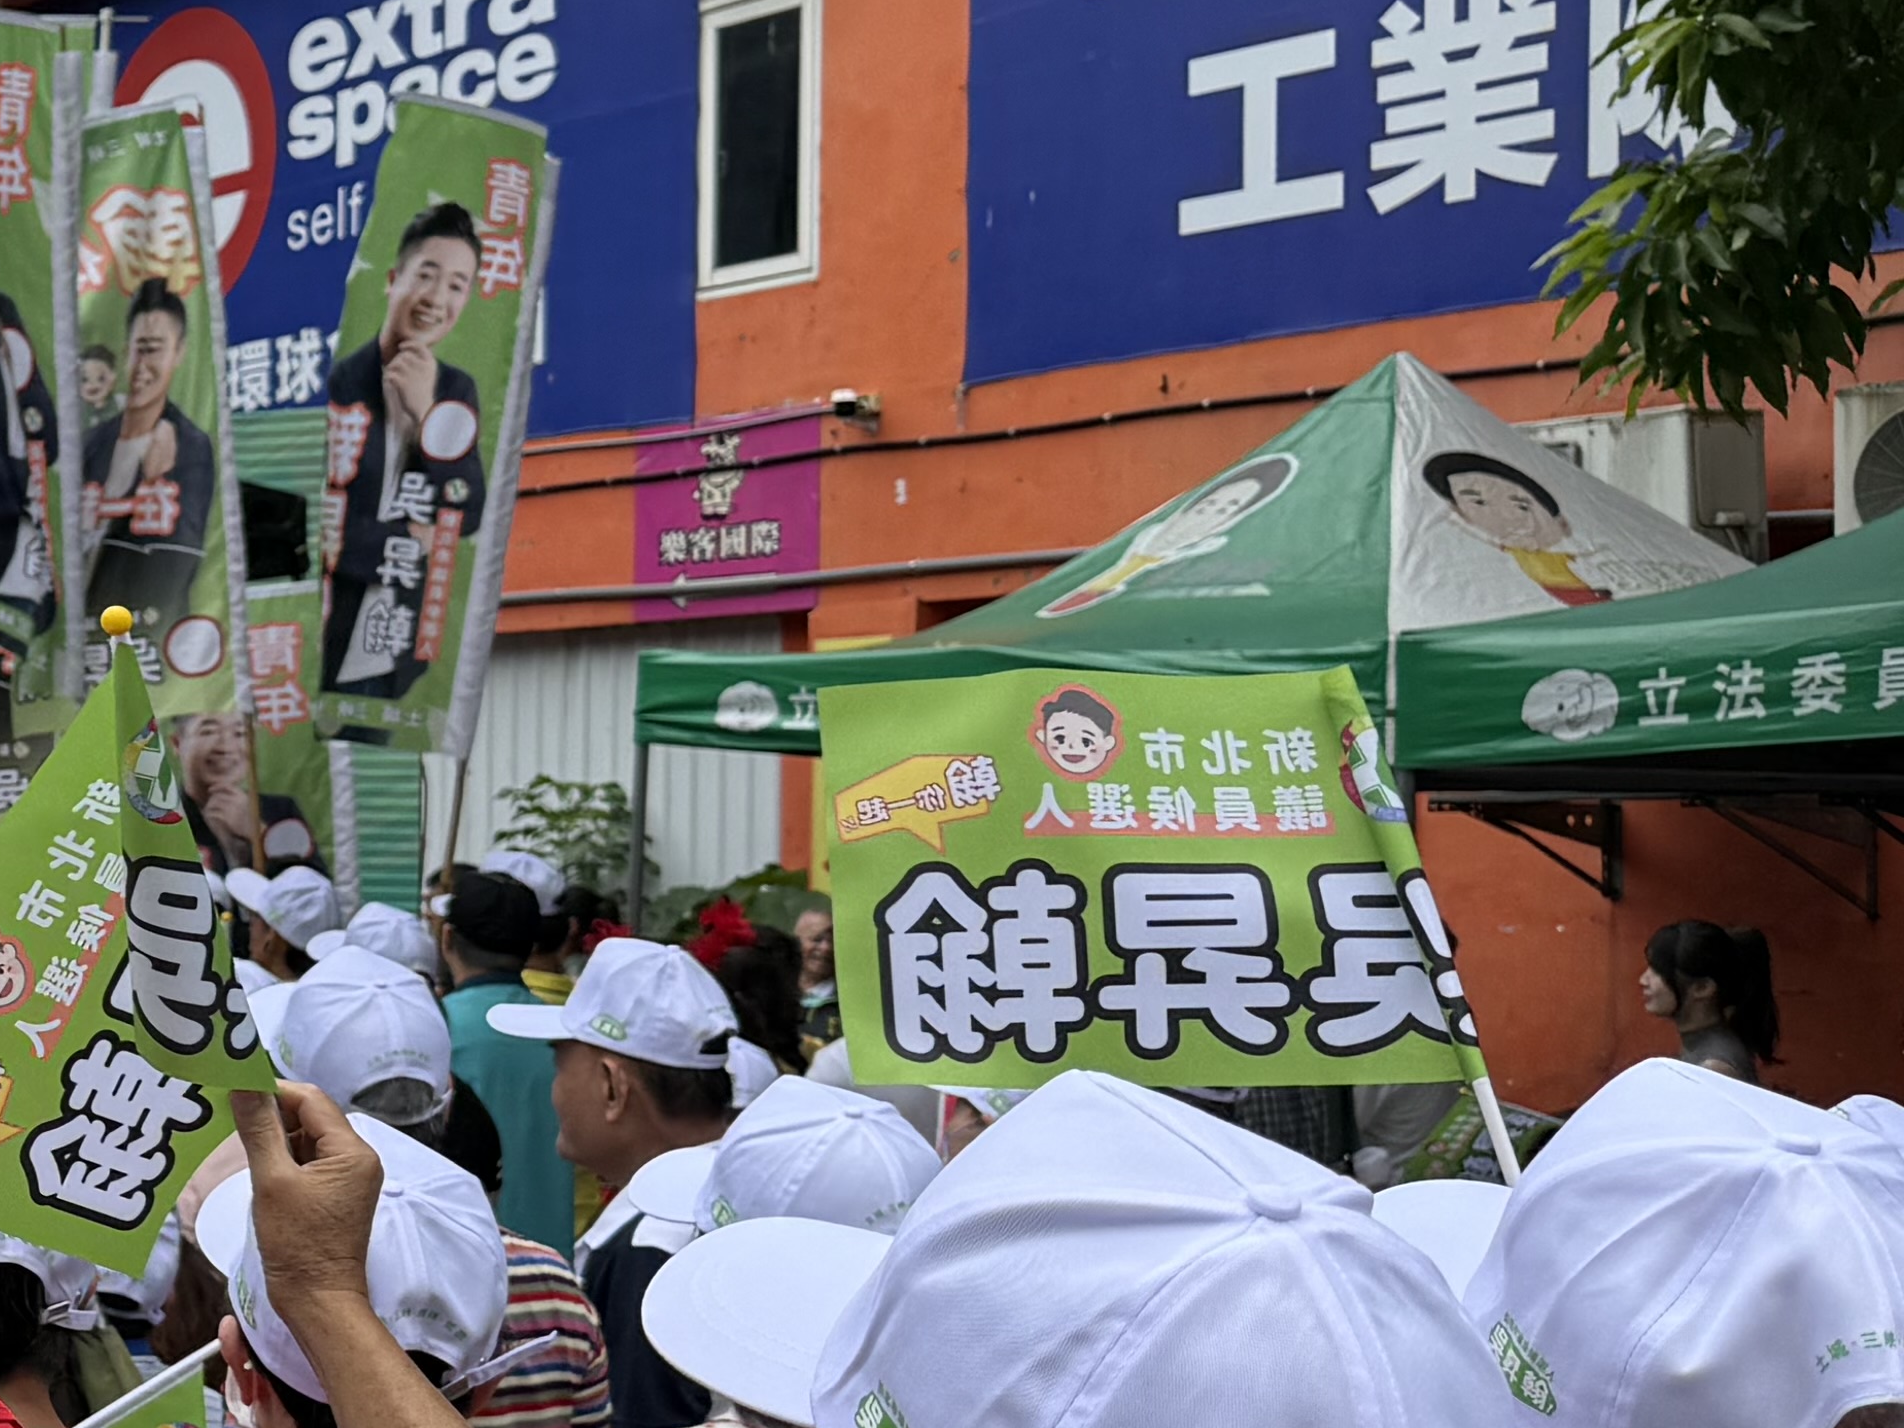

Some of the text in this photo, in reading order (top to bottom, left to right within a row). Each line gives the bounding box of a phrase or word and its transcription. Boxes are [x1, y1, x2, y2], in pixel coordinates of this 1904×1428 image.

[288, 181, 367, 253] self
[226, 327, 339, 414] 環球
[659, 519, 780, 564] 樂客國際
